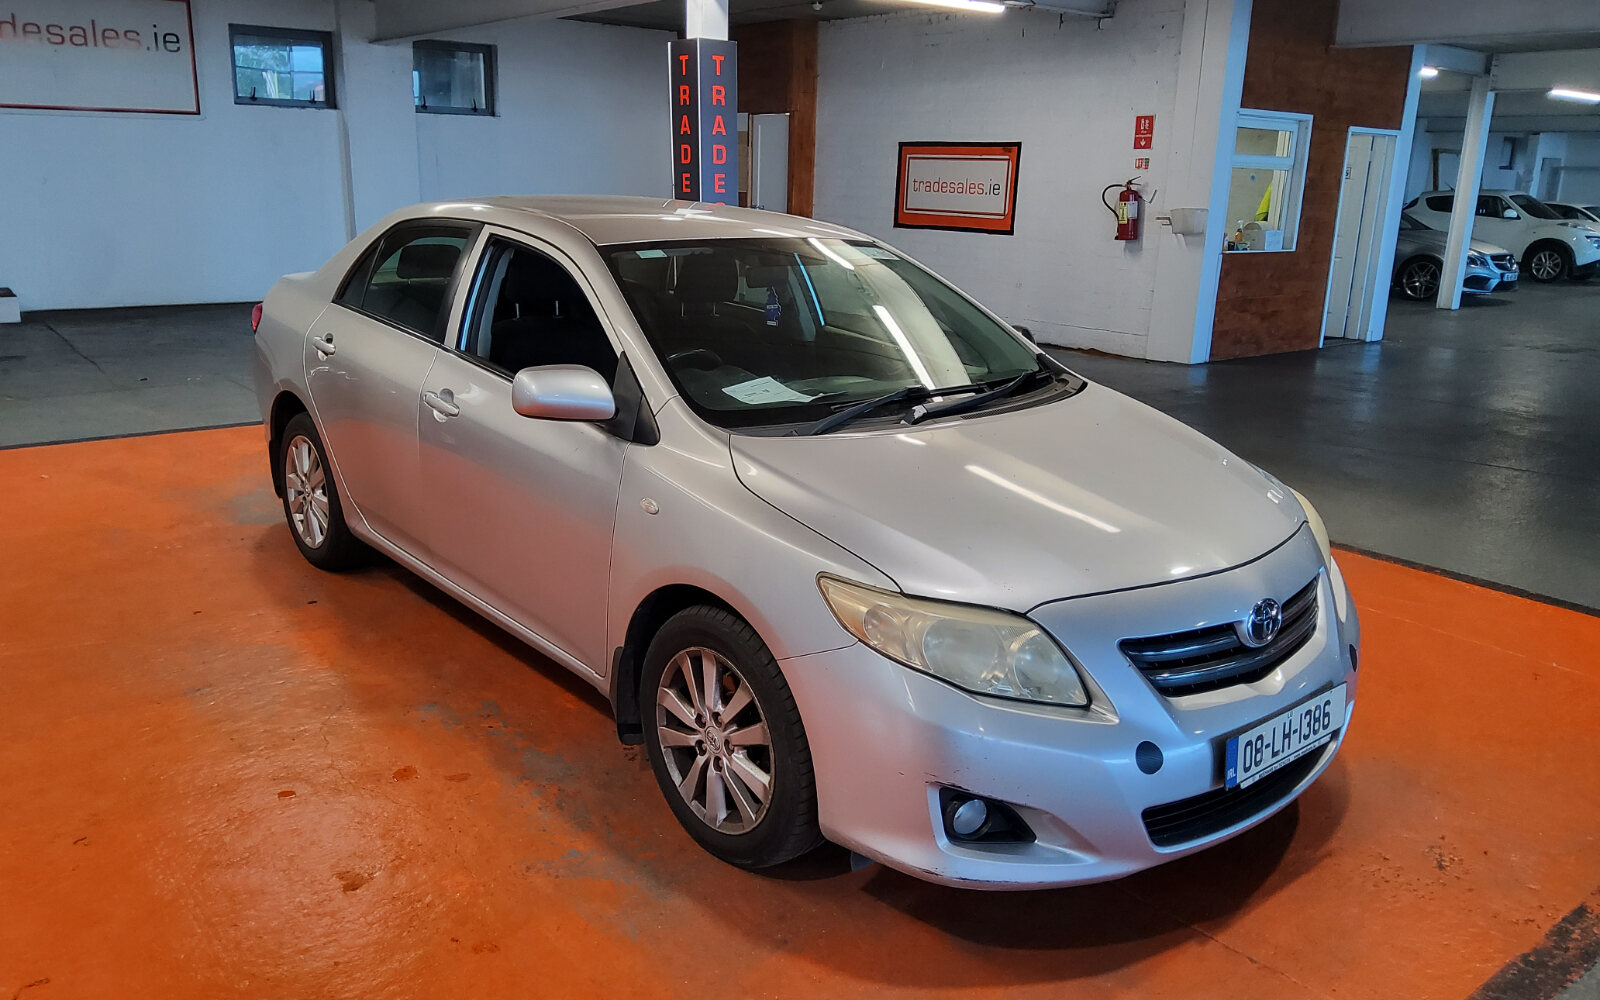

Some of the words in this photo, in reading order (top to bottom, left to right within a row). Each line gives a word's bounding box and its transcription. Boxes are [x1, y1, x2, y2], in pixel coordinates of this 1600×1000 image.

[679, 54, 691, 193] TRADE
[711, 55, 726, 205] TRADE
[912, 177, 1000, 196] tradesales.ie
[1226, 767, 1236, 780] IRL
[1243, 699, 1332, 774] 08-LH-1386
